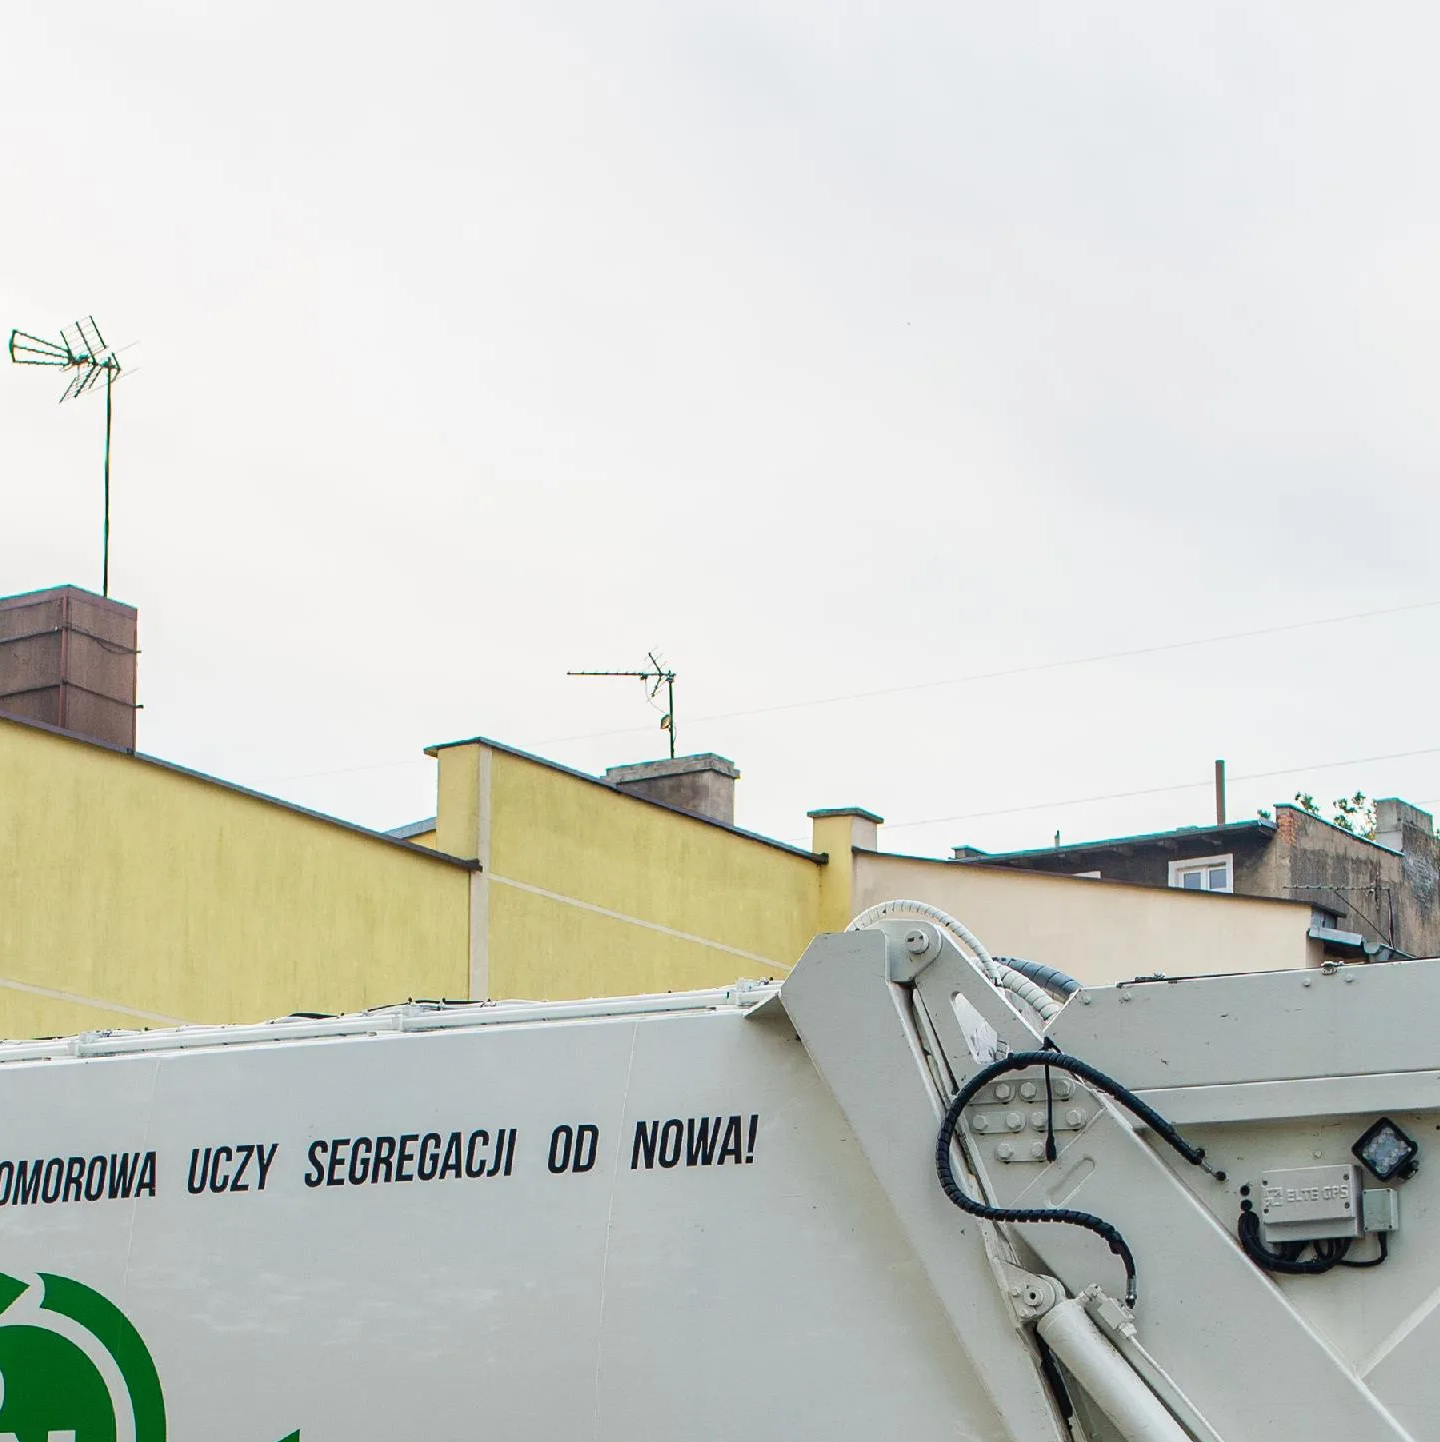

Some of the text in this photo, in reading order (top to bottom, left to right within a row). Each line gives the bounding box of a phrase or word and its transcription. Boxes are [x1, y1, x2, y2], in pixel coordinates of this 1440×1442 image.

[187, 1143, 280, 1195] UCZY
[304, 1128, 518, 1188] SEGREGACJI
[547, 1124, 600, 1174] OD
[630, 1113, 759, 1170] NOWA!
[1322, 1184, 1349, 1201] GPS
